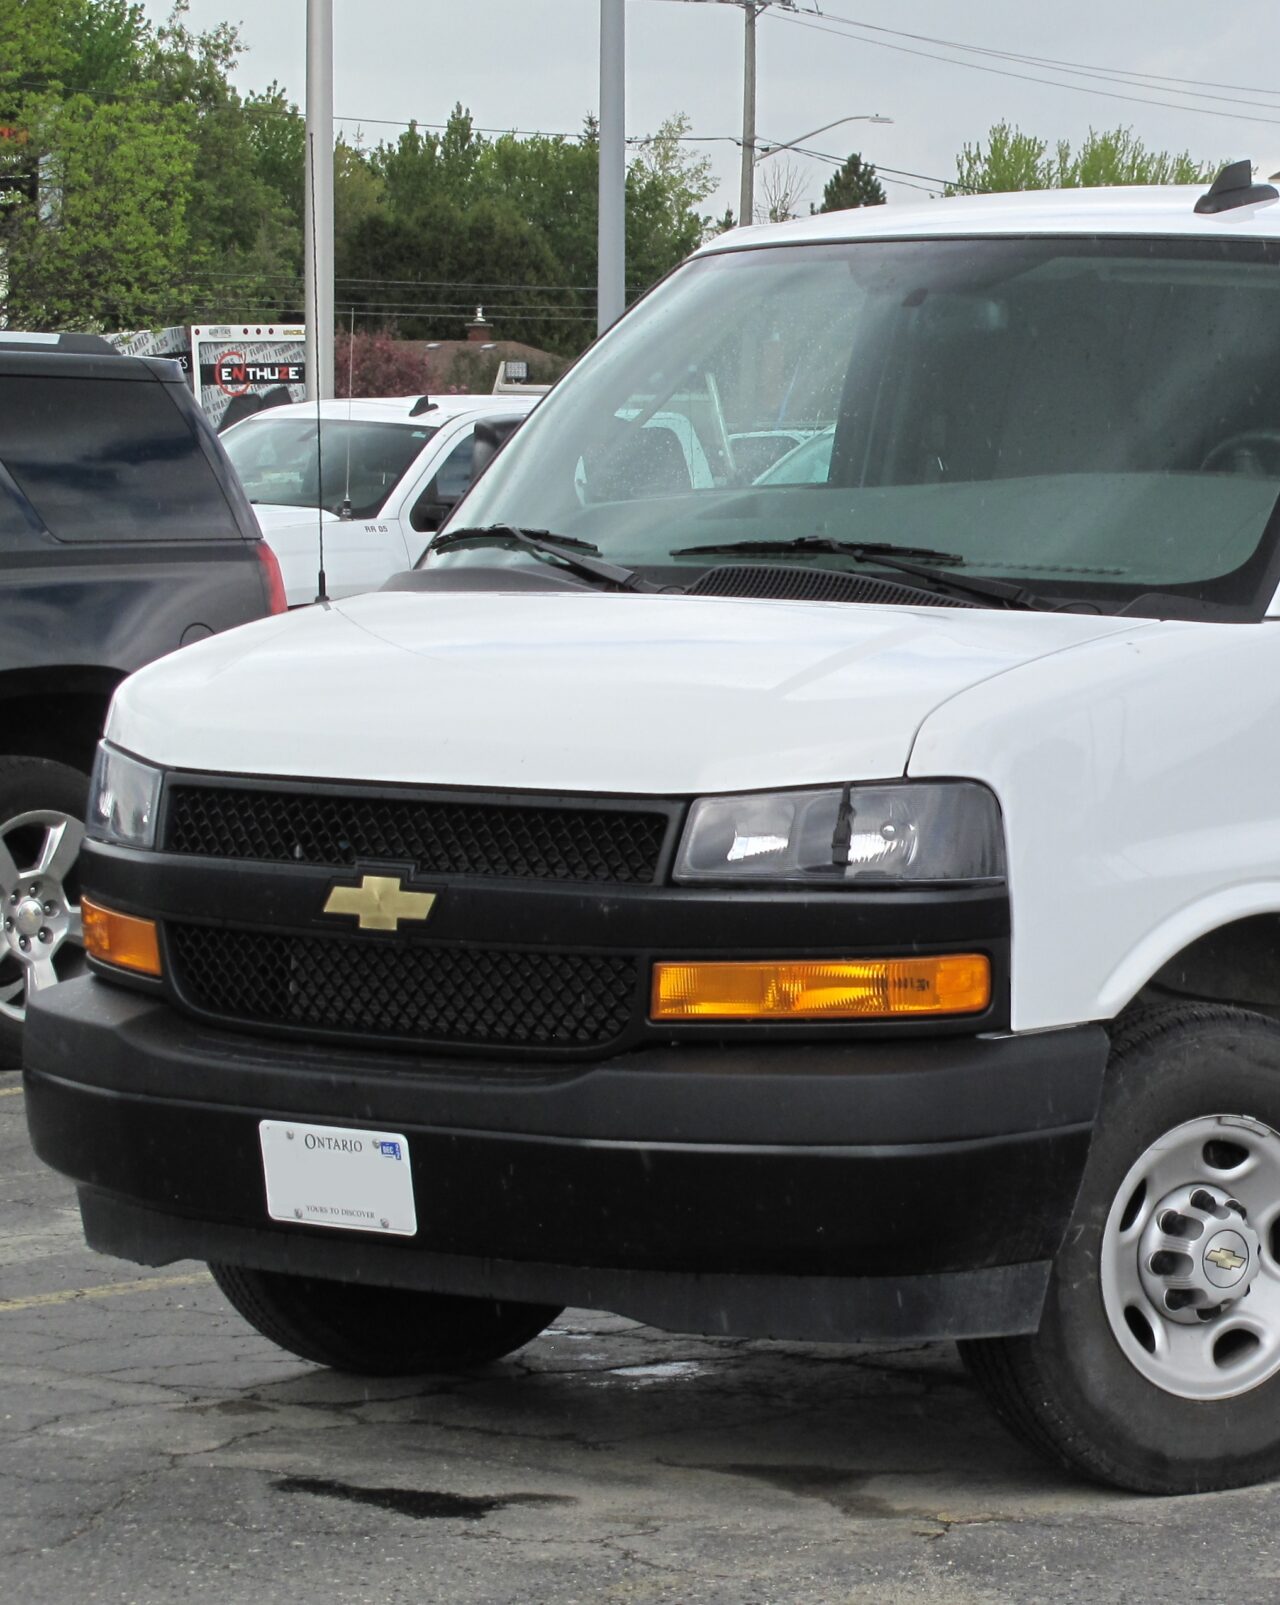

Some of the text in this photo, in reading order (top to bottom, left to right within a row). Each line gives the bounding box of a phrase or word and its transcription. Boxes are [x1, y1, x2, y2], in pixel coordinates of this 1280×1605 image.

[221, 366, 299, 381] ENTHUZE
[306, 1205, 375, 1219] YOURS TO DISCOVER
